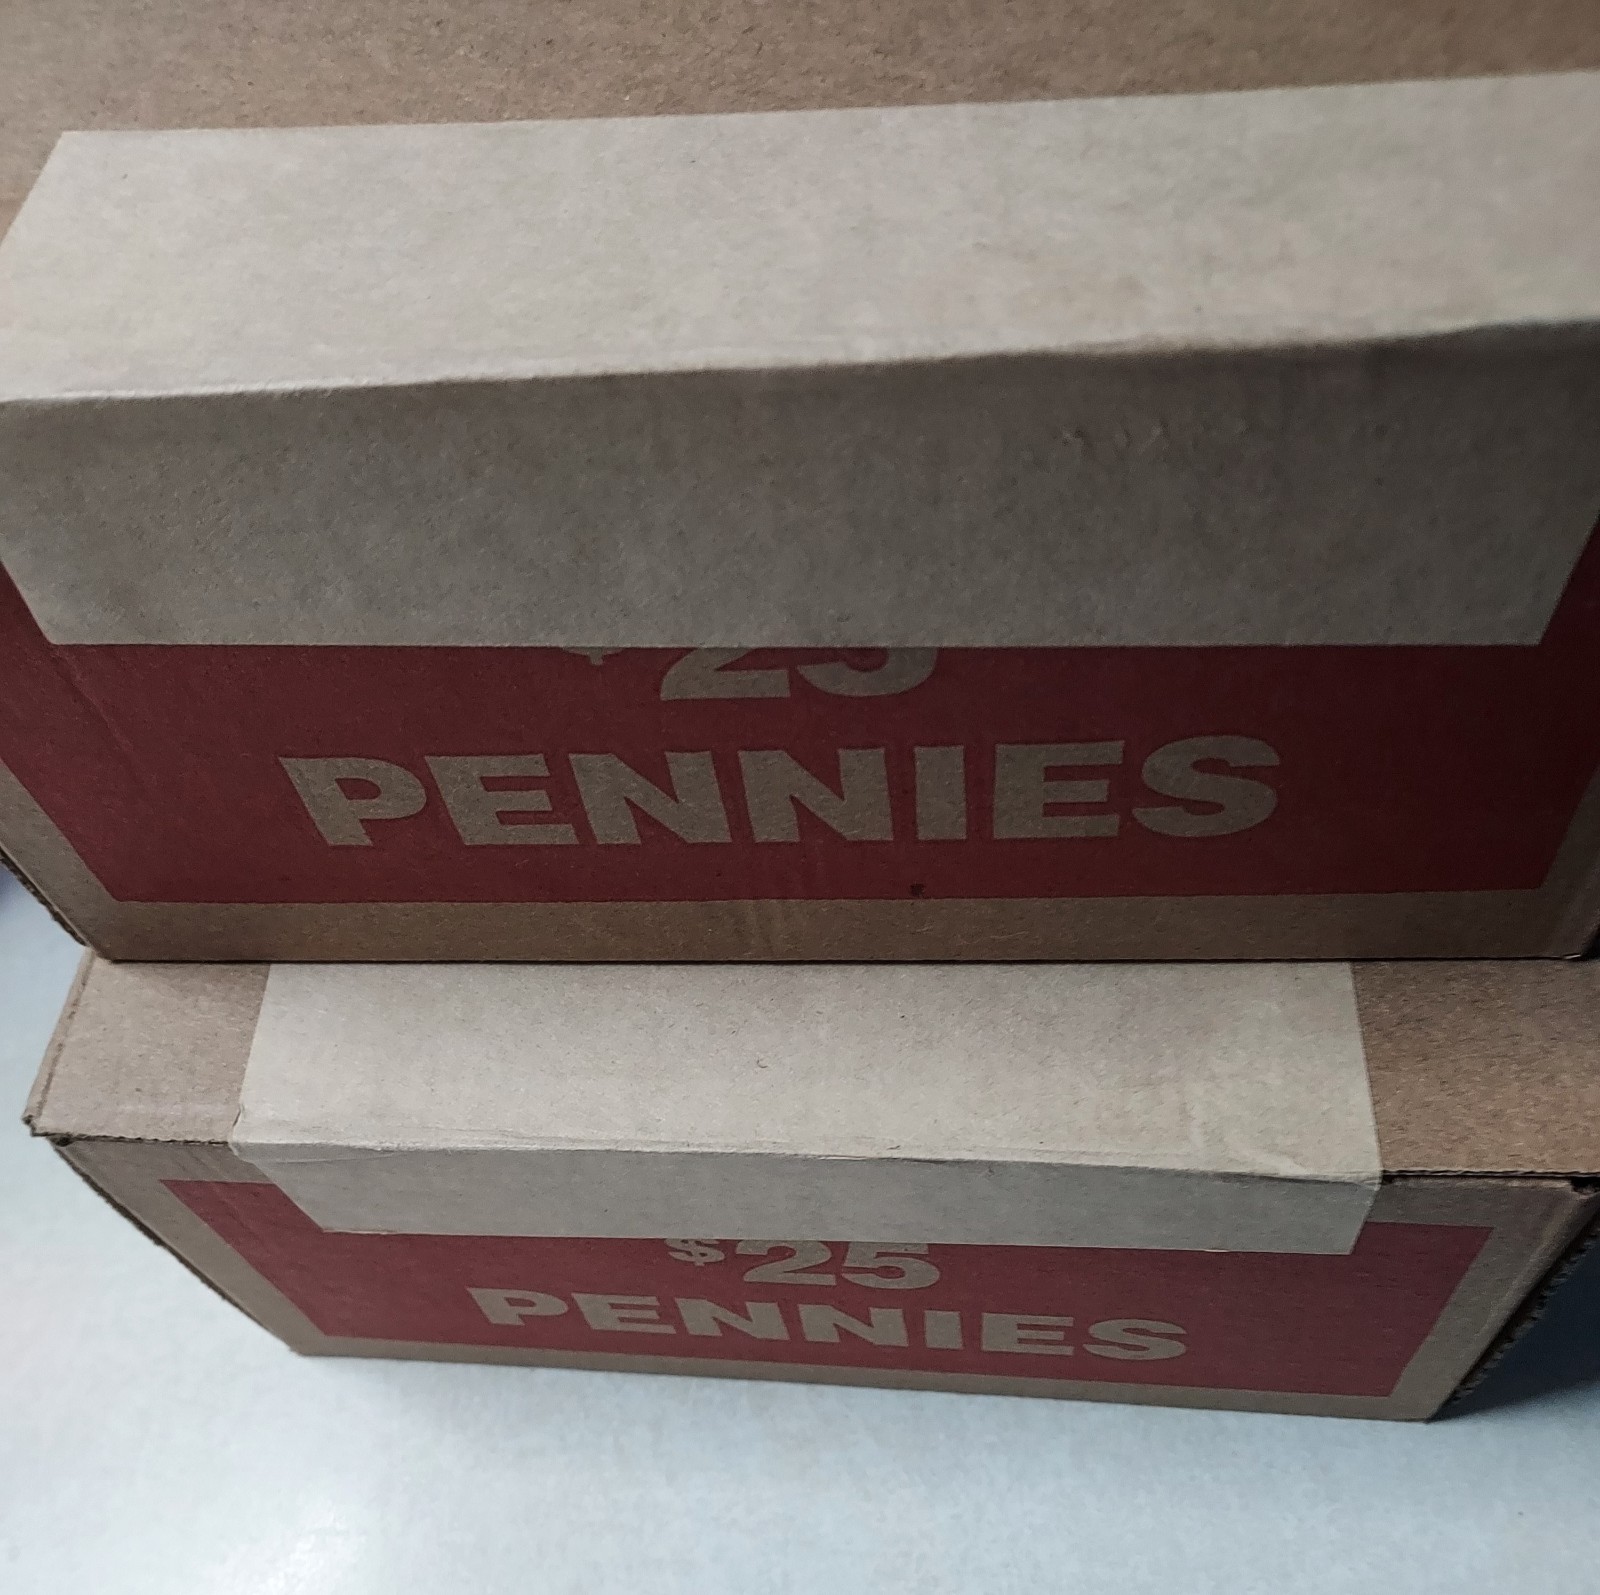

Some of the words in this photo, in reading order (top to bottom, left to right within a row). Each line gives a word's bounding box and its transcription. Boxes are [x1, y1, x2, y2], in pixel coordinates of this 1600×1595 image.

[279, 735, 1281, 847] PENNIES
[664, 1239, 940, 1290] $25
[466, 1286, 1188, 1362] PENNIES
